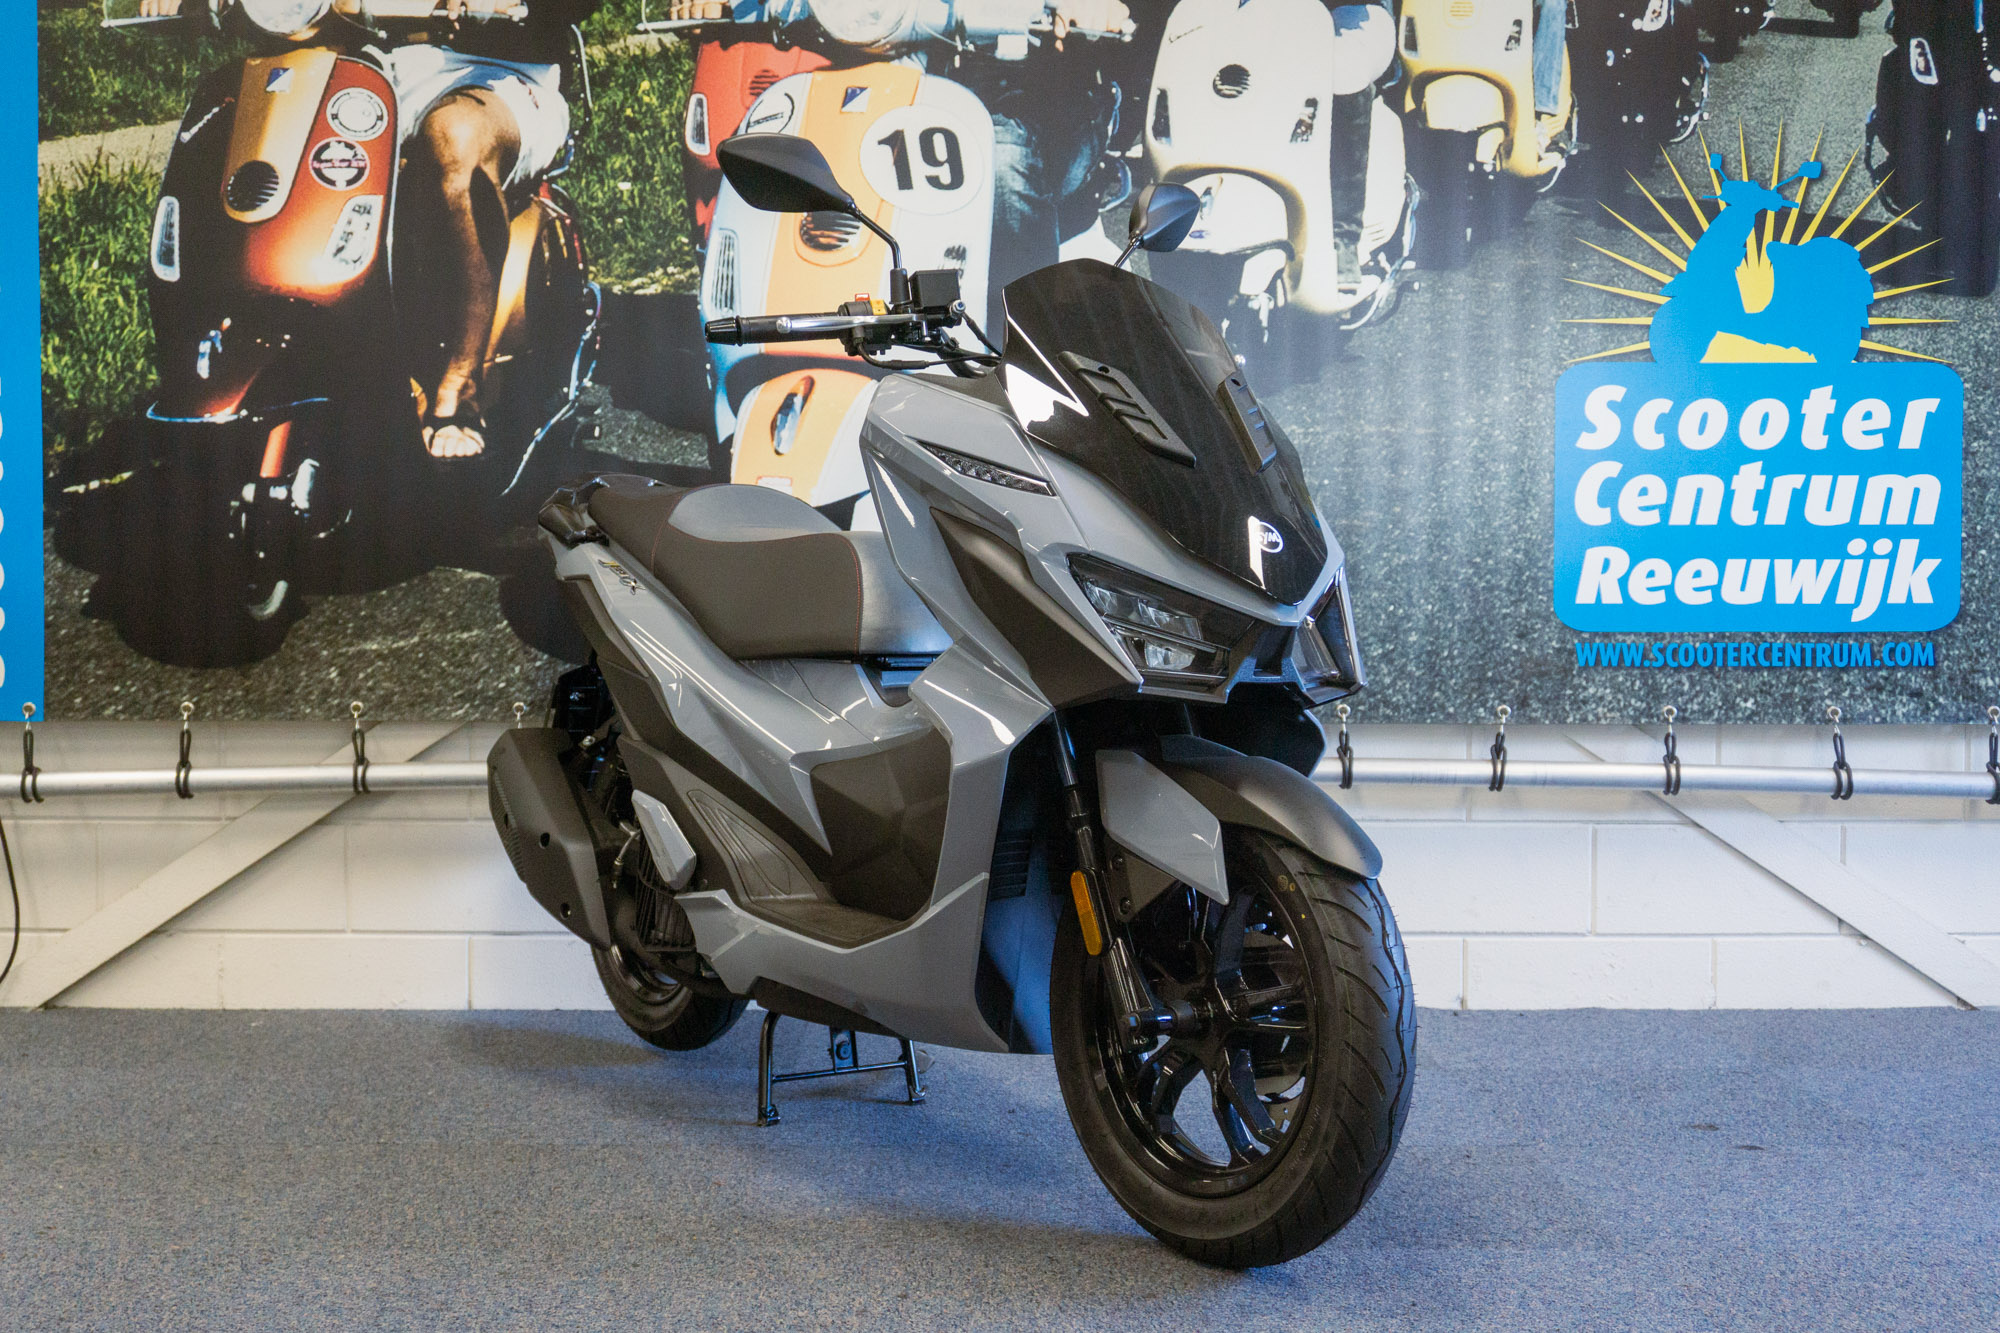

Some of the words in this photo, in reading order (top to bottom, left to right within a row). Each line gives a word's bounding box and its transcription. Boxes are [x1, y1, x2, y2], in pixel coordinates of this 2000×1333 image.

[877, 127, 965, 191] 19
[1575, 384, 1941, 452] Scooter
[1573, 460, 1942, 526] Centrum
[1575, 538, 1942, 622] Reeuwijk
[1575, 642, 1935, 668] WWW.SCOOTERCENTRUM.COM
